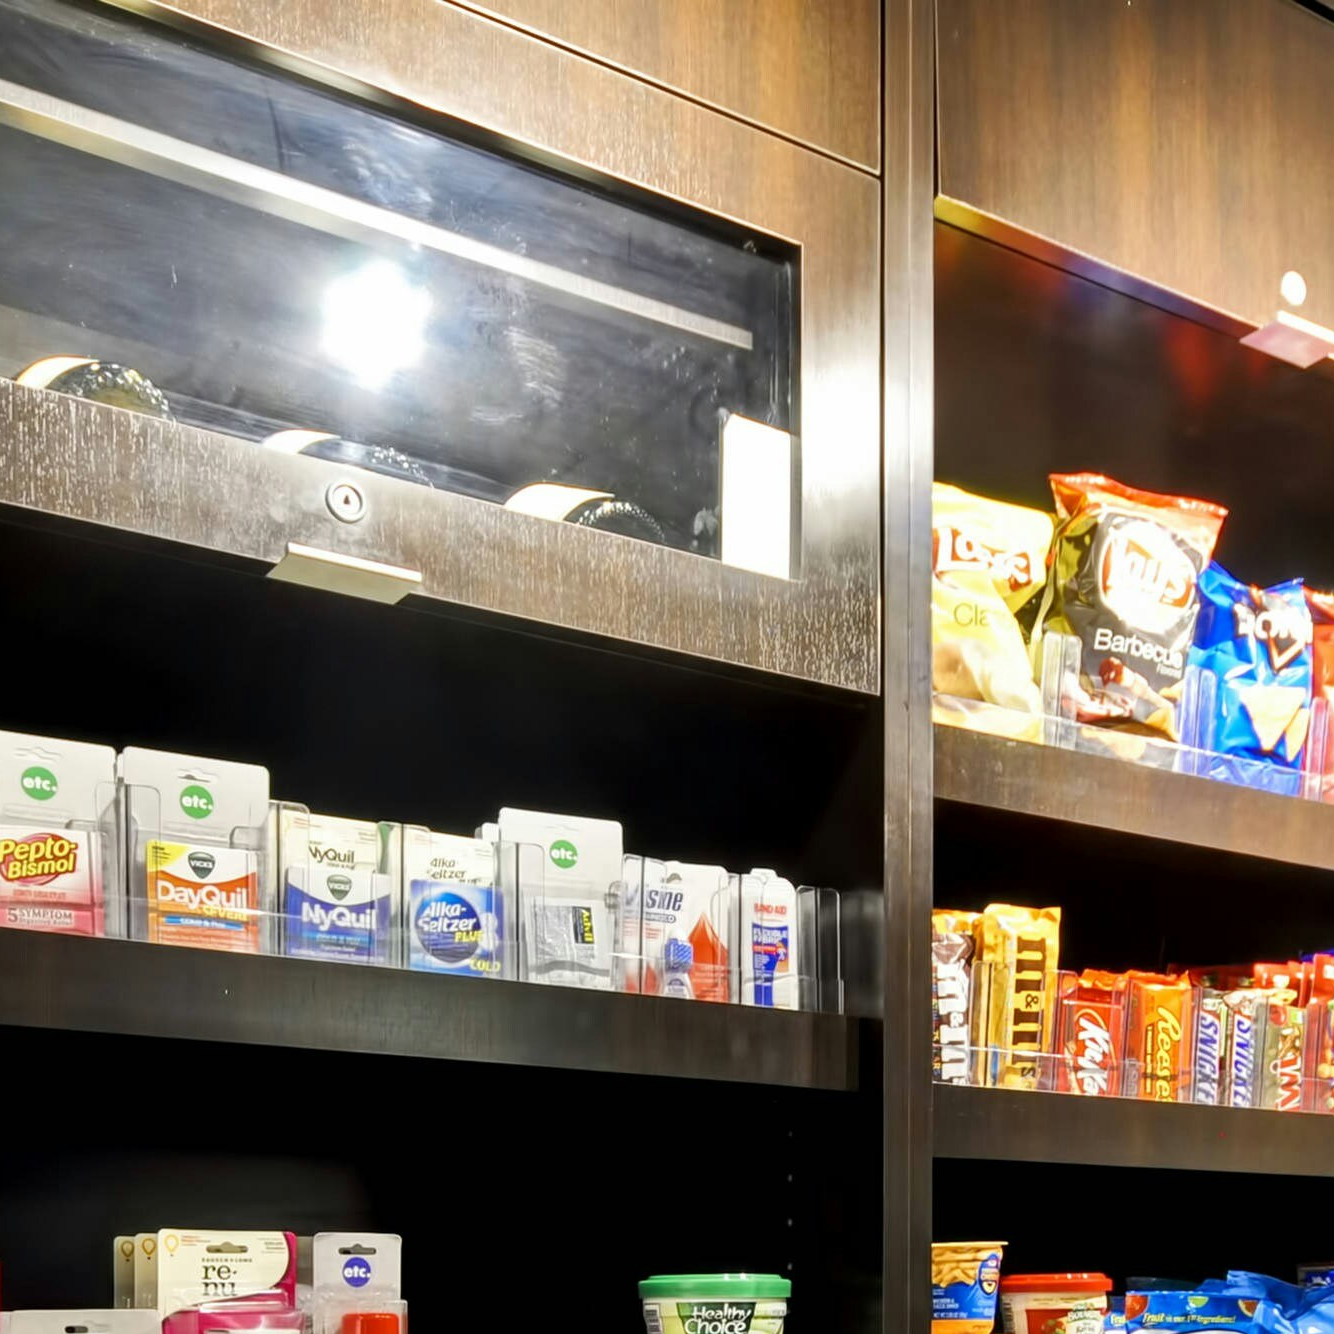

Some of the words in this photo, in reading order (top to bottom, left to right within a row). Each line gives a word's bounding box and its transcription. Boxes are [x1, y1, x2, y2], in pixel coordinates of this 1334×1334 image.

[1093, 628, 1183, 670] Barbecue
[22, 775, 57, 792] etc.
[181, 794, 213, 811] etc.
[551, 849, 578, 861] etc.
[8, 852, 75, 880] Bismol
[156, 879, 248, 910] DayQuil
[7, 907, 18, 923] 5
[18, 908, 73, 921] SYMPTOM
[301, 901, 377, 932] NyQuil
[423, 901, 467, 917] Alka-
[418, 917, 478, 932] Seltzer
[582, 910, 595, 942] Advil
[344, 1266, 371, 1279] etc.
[692, 1303, 752, 1322] Healthy
